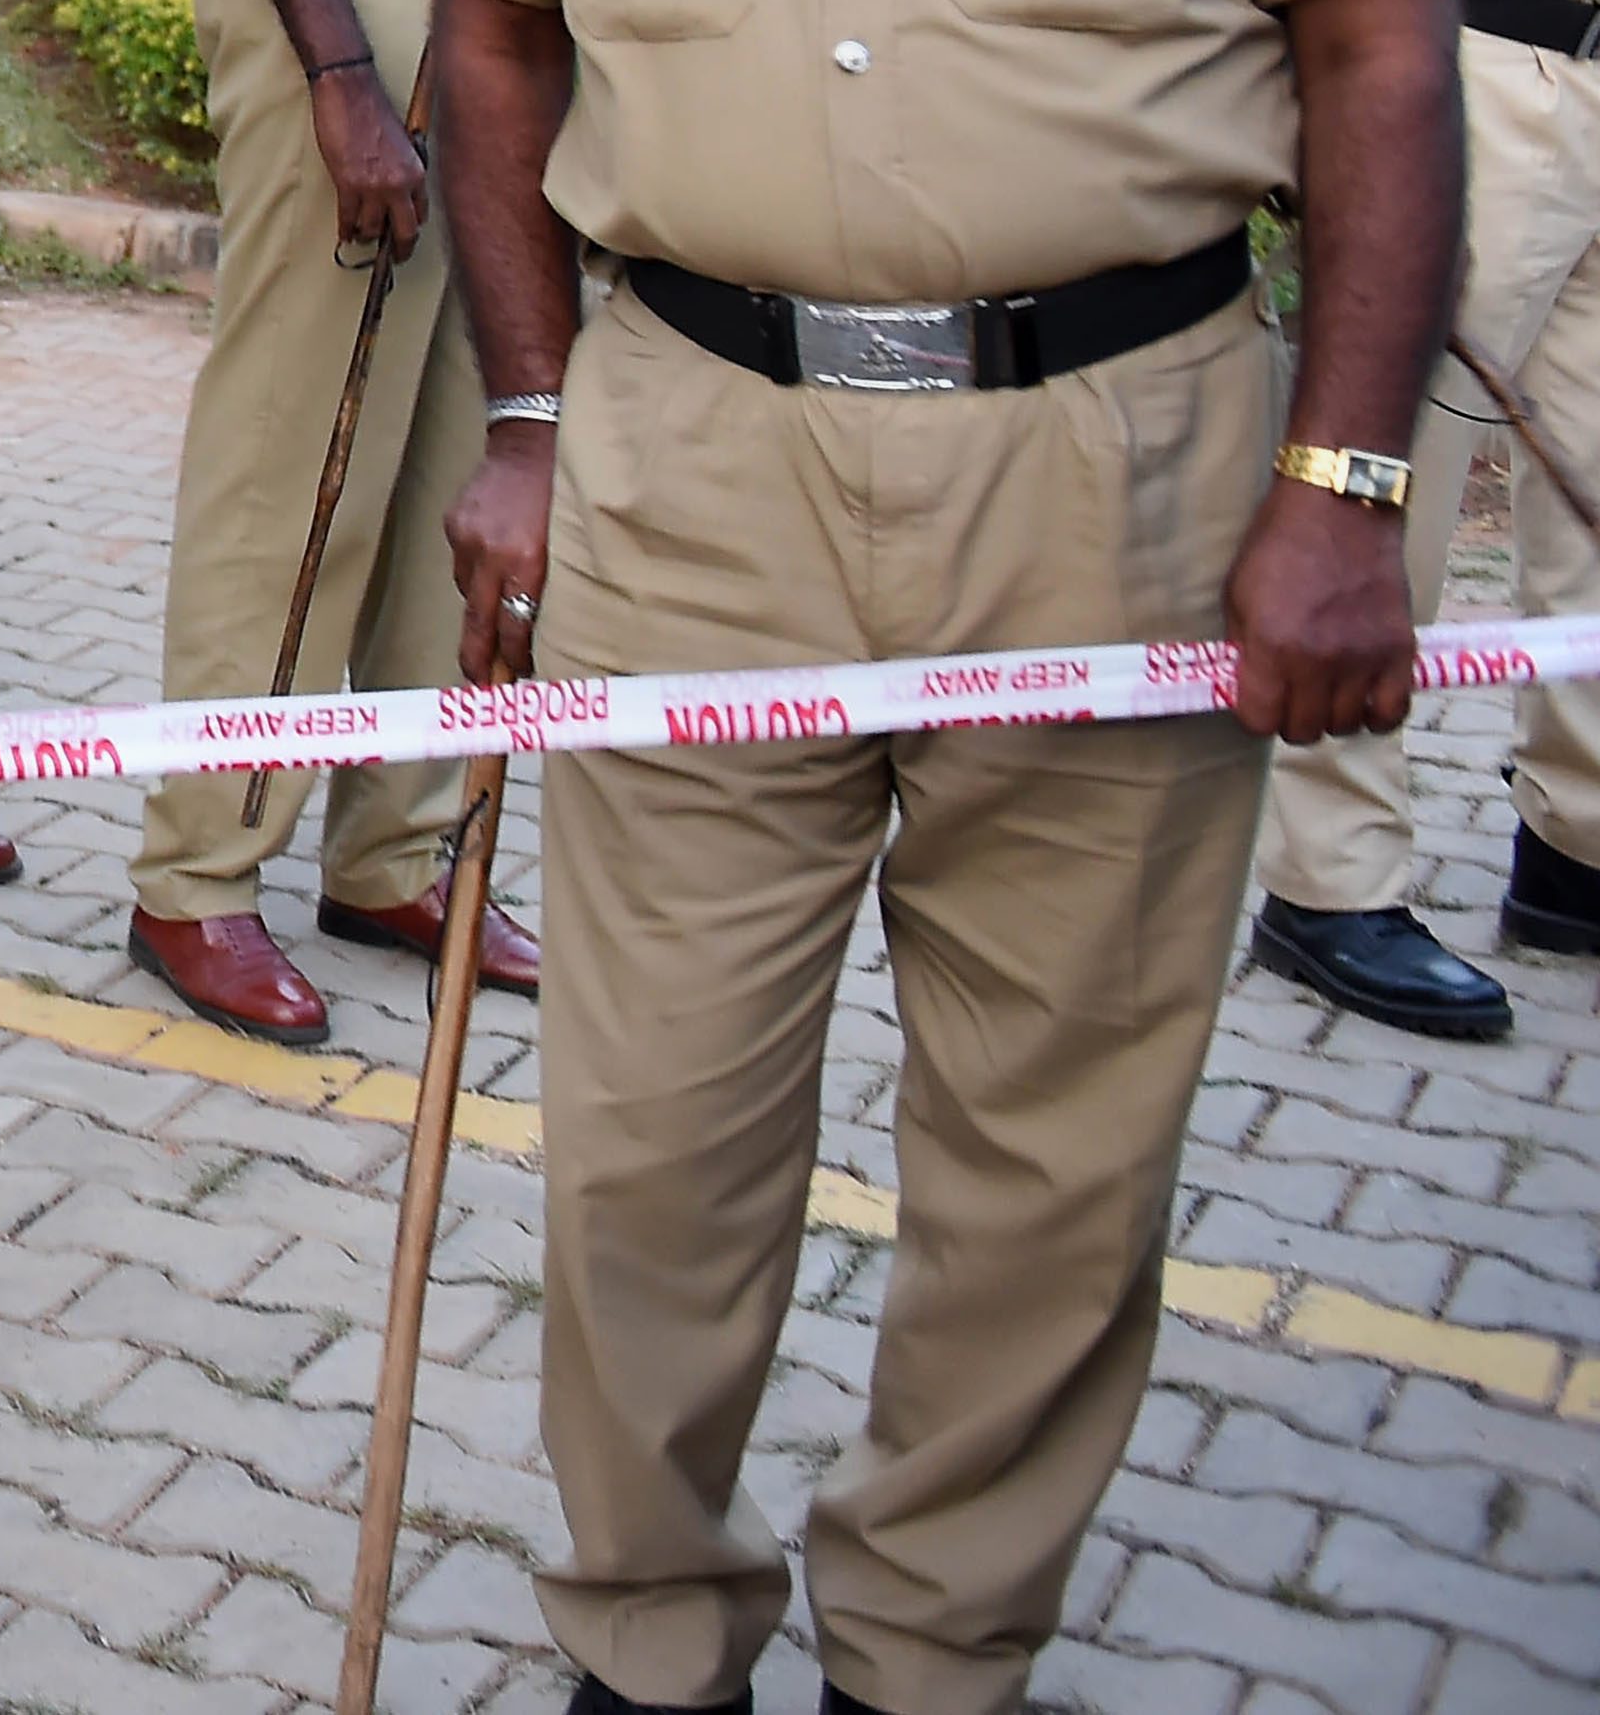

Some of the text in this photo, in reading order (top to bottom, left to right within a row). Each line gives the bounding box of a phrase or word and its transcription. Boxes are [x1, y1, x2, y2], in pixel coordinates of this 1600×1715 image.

[922, 663, 1088, 696] KEEP AWAY
[200, 708, 377, 738] KEEP AWAY
[438, 682, 610, 732] PROGRESS
